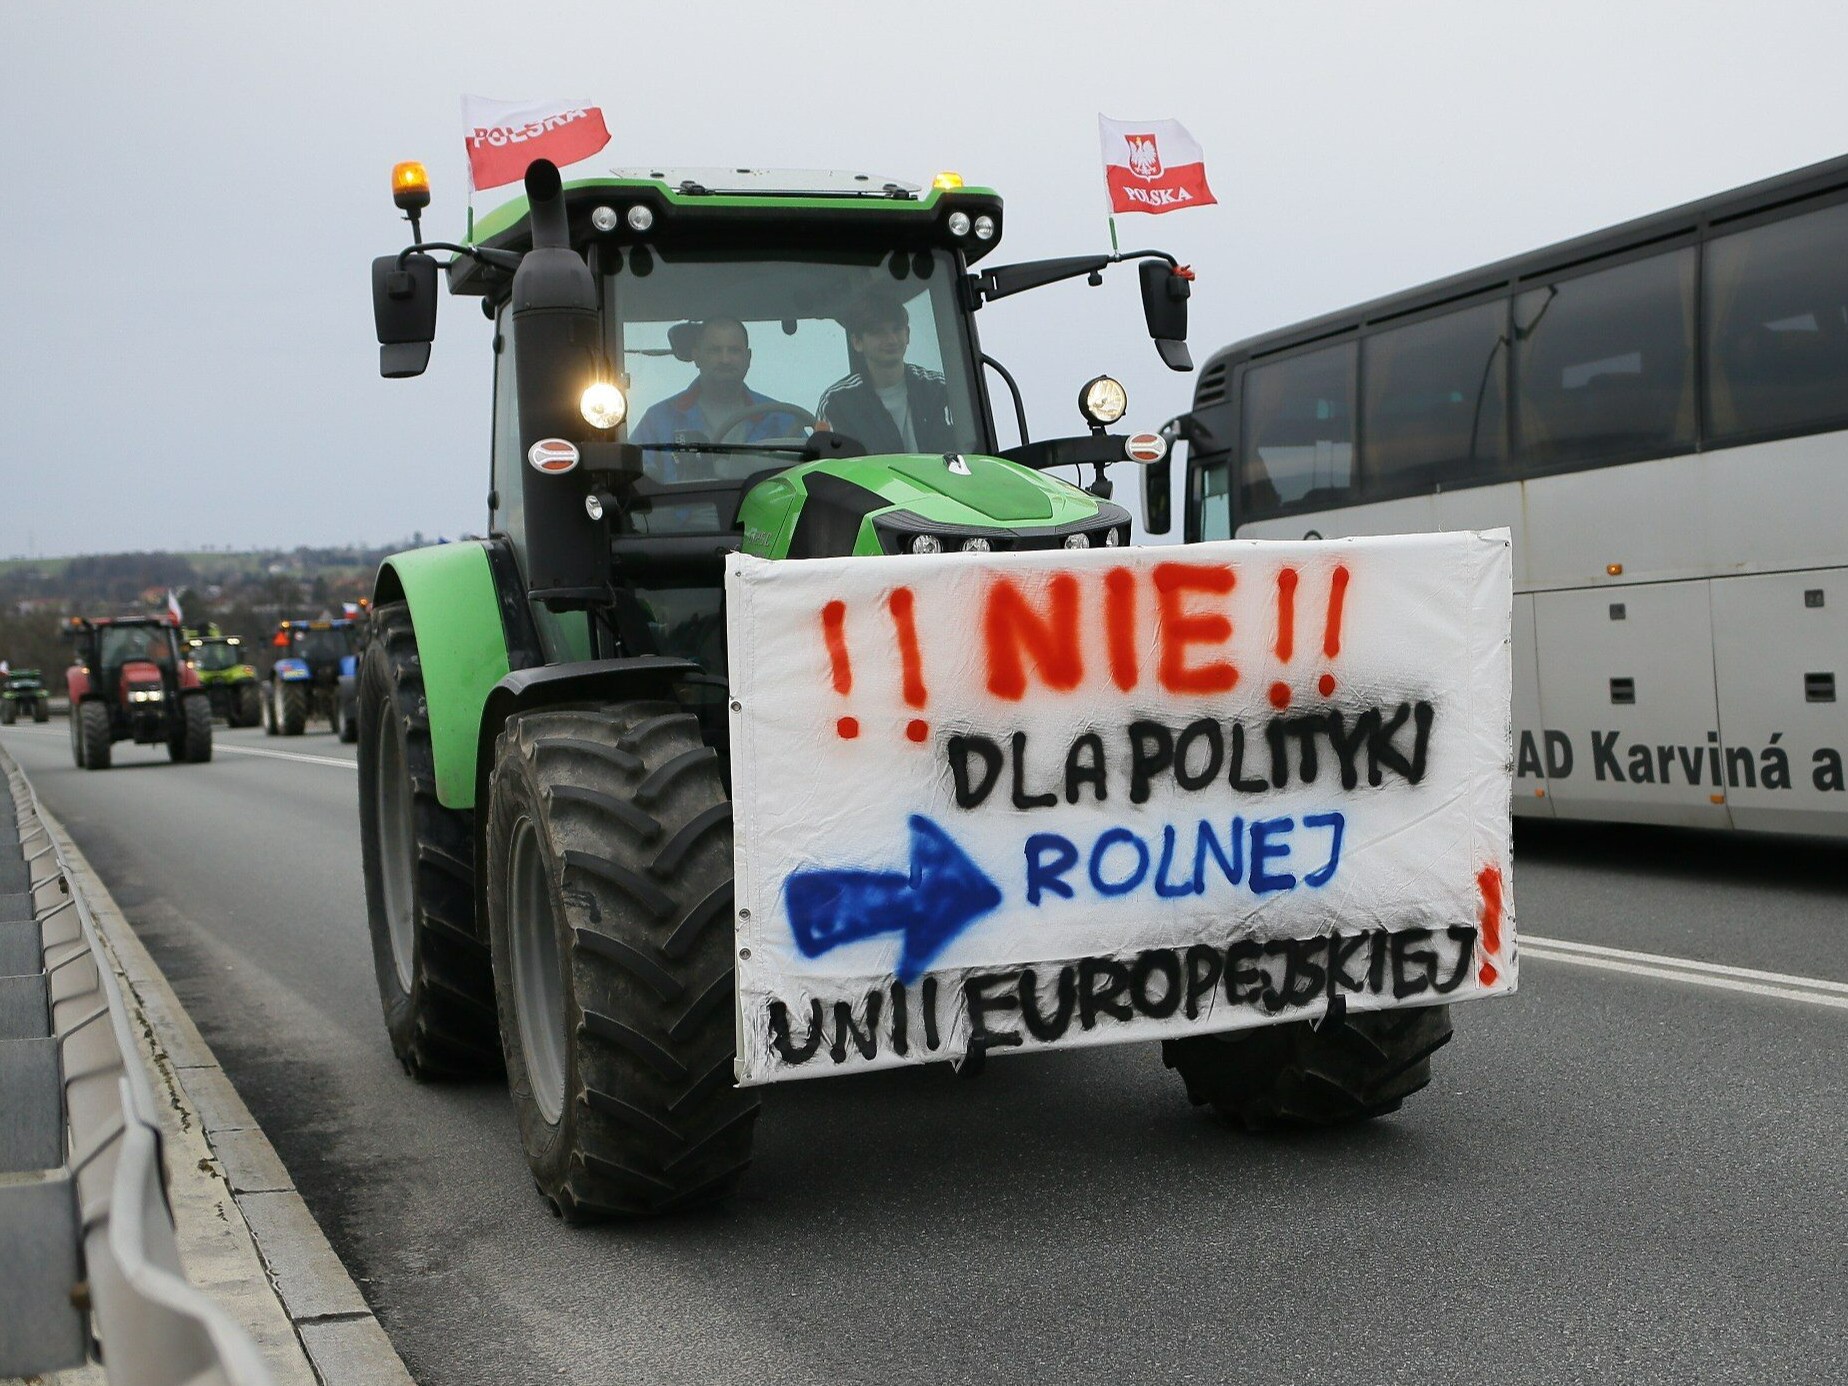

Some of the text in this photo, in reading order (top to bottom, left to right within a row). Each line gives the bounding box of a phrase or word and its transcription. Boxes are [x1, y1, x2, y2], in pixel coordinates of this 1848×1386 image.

[1123, 186, 1194, 206] POLSKA
[946, 700, 1434, 809] DLA POLITYKI
[1591, 730, 1792, 790] Karviná
[1024, 812, 1345, 905] ROLNEJ
[768, 978, 940, 1064] UNII
